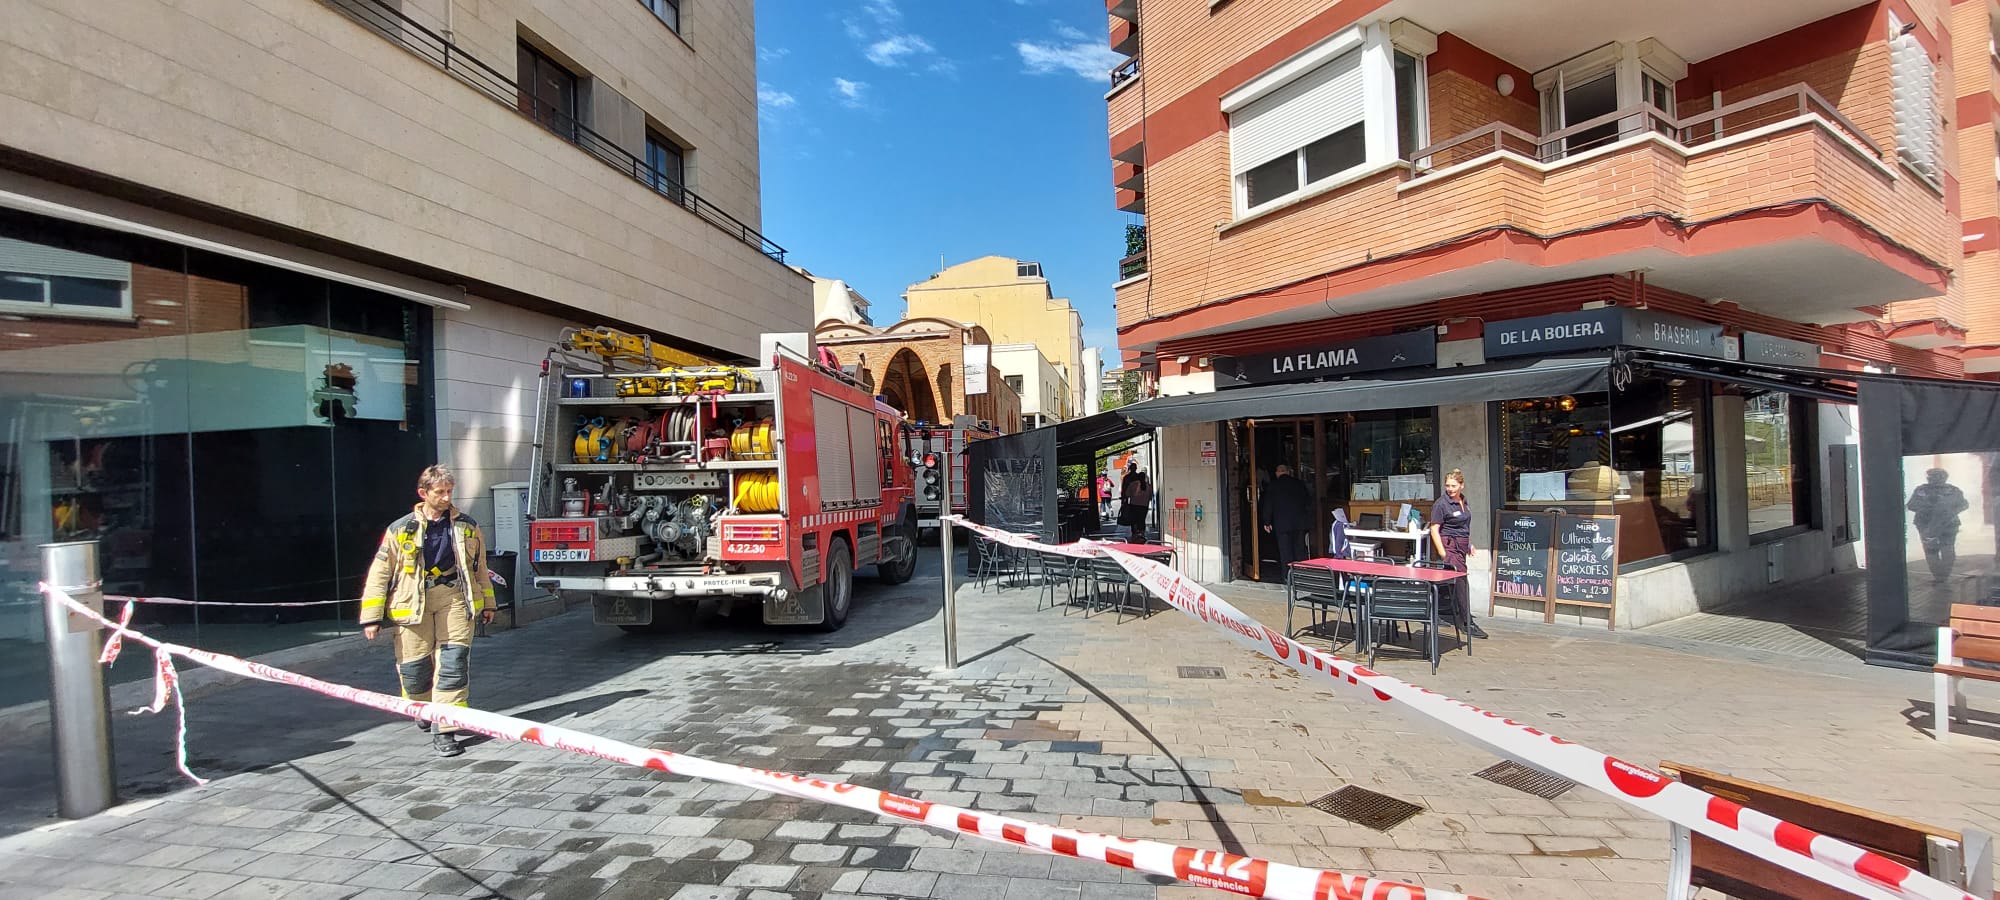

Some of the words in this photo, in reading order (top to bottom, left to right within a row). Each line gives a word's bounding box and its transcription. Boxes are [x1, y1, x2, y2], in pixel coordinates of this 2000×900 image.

[1500, 327, 1518, 345] DE
[1521, 324, 1541, 343] LA
[1544, 321, 1604, 340] BOLERA
[1654, 322, 1700, 345] BRASERIA
[1273, 356, 1294, 374] LA
[1297, 348, 1359, 371] FLAMA
[1592, 532, 1613, 544] dies
[542, 550, 568, 560] 8595
[727, 544, 766, 553] 4.22.30
[1187, 873, 1250, 893] emergències
